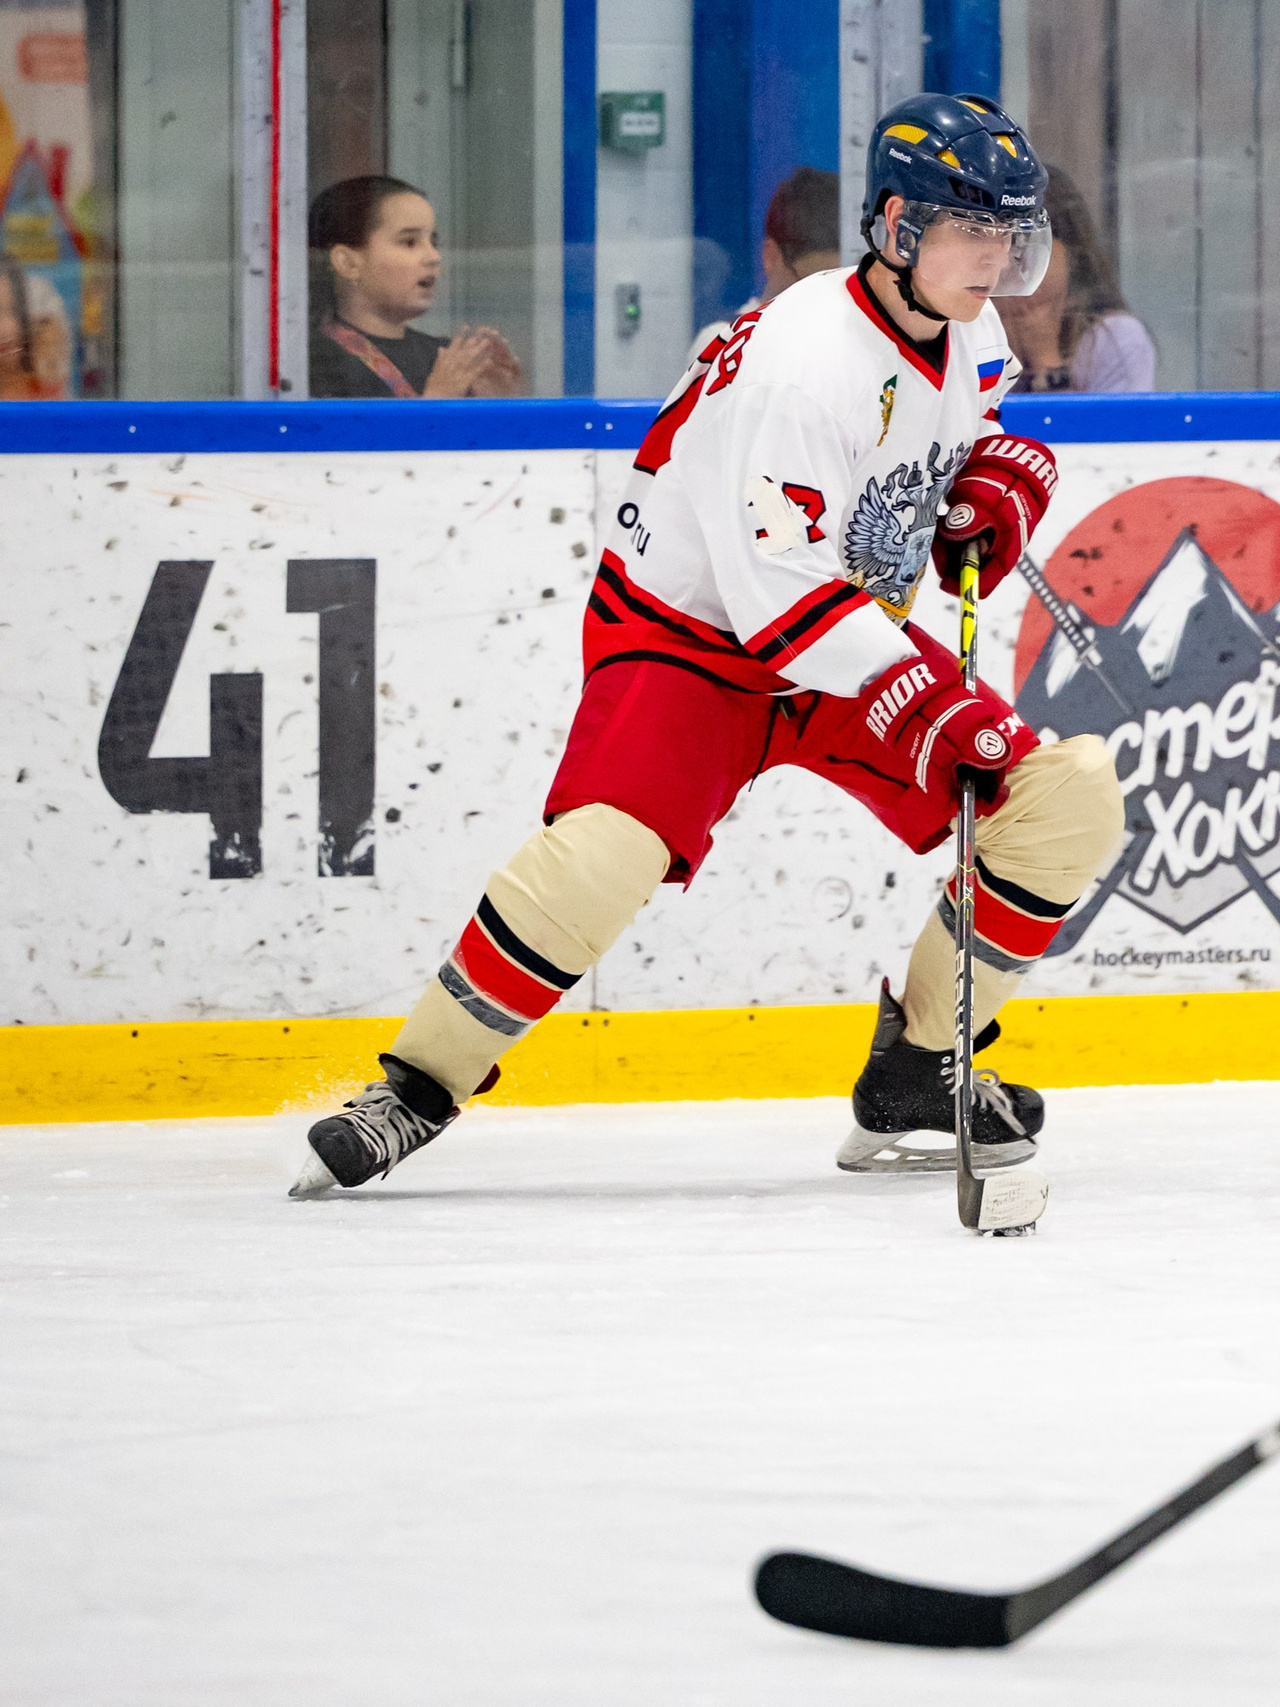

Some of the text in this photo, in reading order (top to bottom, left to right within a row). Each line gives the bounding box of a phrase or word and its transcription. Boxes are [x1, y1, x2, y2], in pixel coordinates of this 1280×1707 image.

[1001, 194, 1037, 206] Reebok
[98, 558, 377, 879] 41
[1093, 946, 1271, 969] hockeymasters.ru
